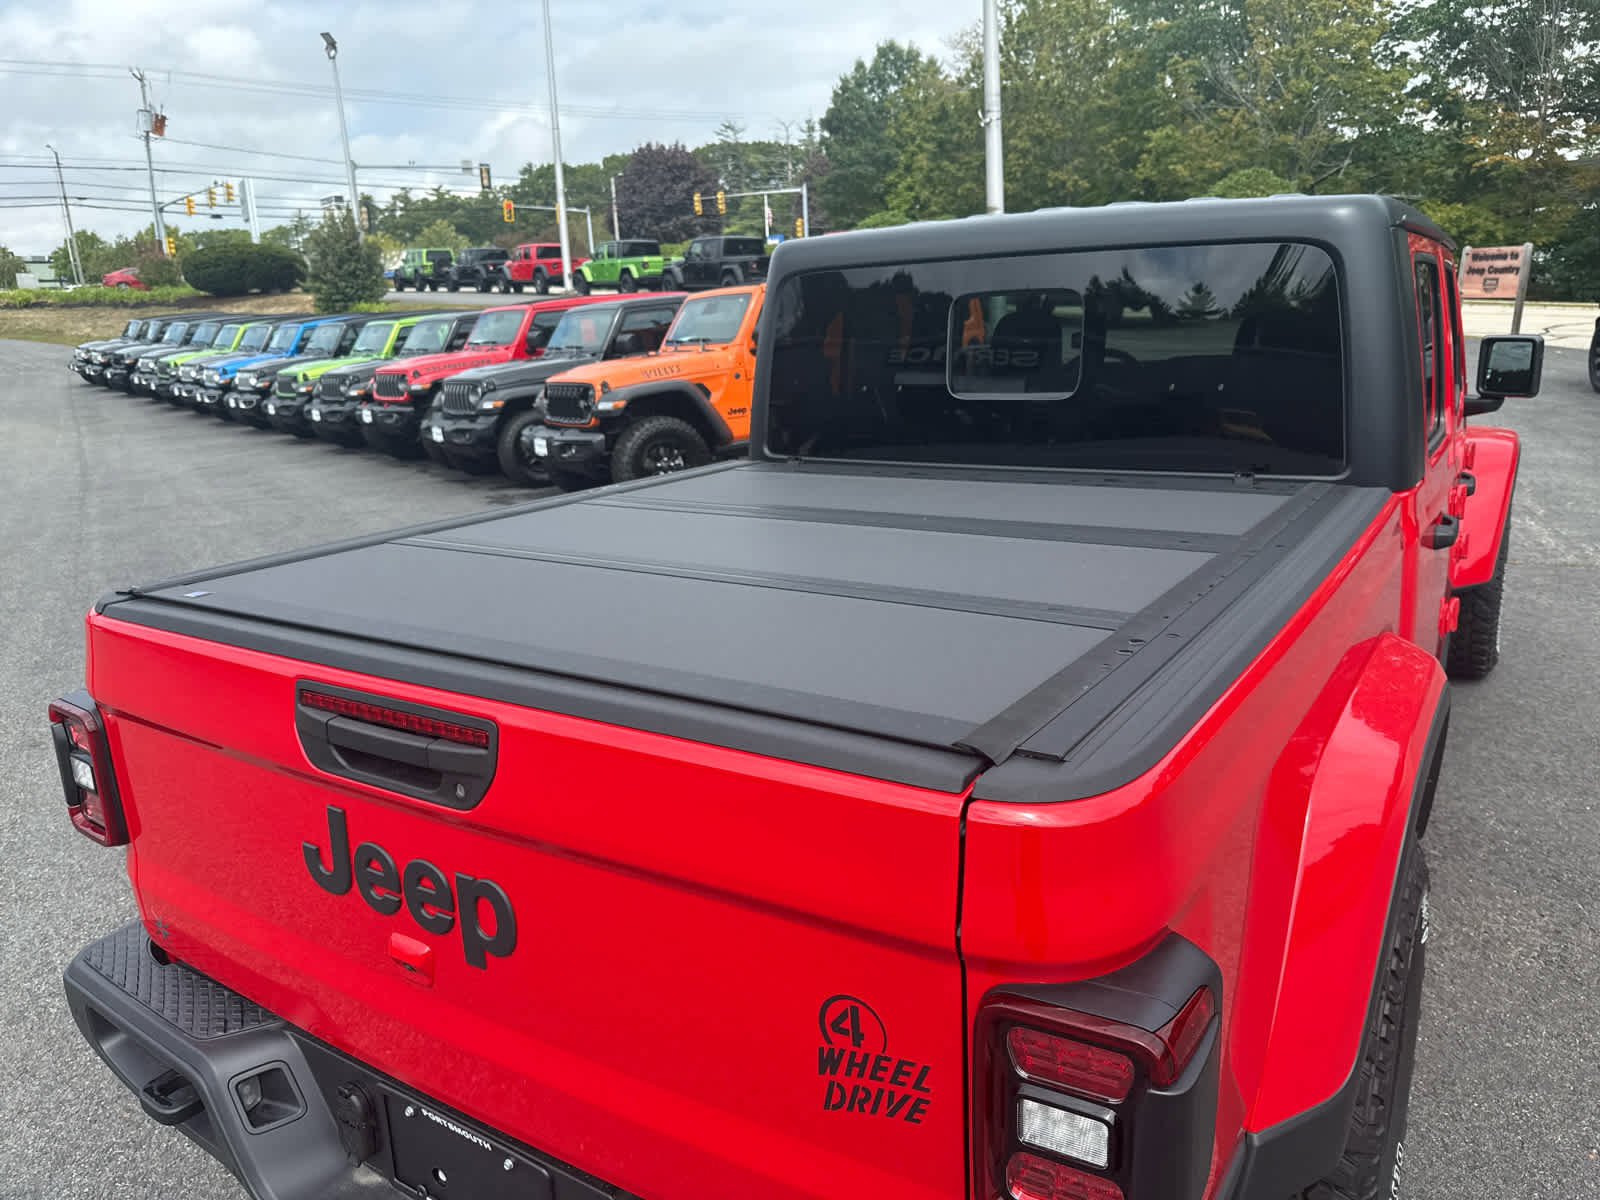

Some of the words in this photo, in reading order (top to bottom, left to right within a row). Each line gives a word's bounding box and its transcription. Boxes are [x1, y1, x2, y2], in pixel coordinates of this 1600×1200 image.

[1466, 265, 1486, 276] Jeep
[1488, 265, 1520, 276] Country
[1470, 252, 1508, 262] Welcome
[1510, 251, 1519, 260] to
[728, 407, 747, 416] Jeep
[302, 804, 517, 970] Jeep
[830, 1004, 865, 1048] 4
[818, 1046, 931, 1093] WHEEL
[823, 1080, 931, 1125] DRIVE
[421, 1108, 492, 1151] PORTSMOUTH
